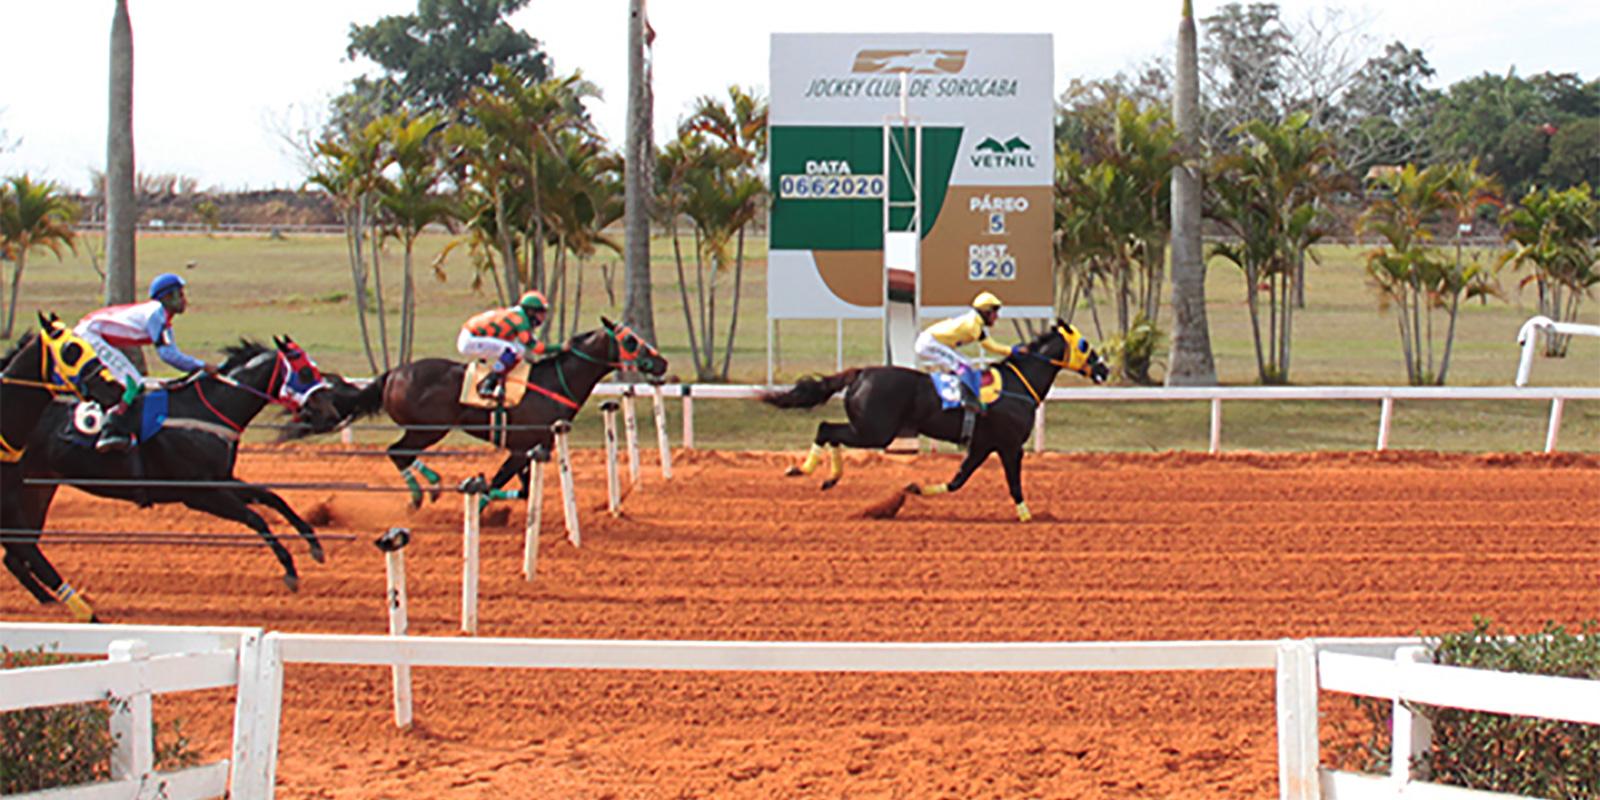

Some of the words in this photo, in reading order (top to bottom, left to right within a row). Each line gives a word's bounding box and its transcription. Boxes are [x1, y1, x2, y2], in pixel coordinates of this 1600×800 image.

[805, 78, 864, 97] JOCKEY
[865, 78, 904, 97] CLUB
[909, 78, 931, 97] DE
[935, 78, 1018, 97] SOROCABA
[805, 160, 852, 175] DATA
[970, 155, 1035, 167] VETNIL
[970, 194, 1029, 212] PÁREO
[991, 213, 1003, 232] 5
[971, 260, 1014, 277] 320
[74, 400, 103, 434] 6
